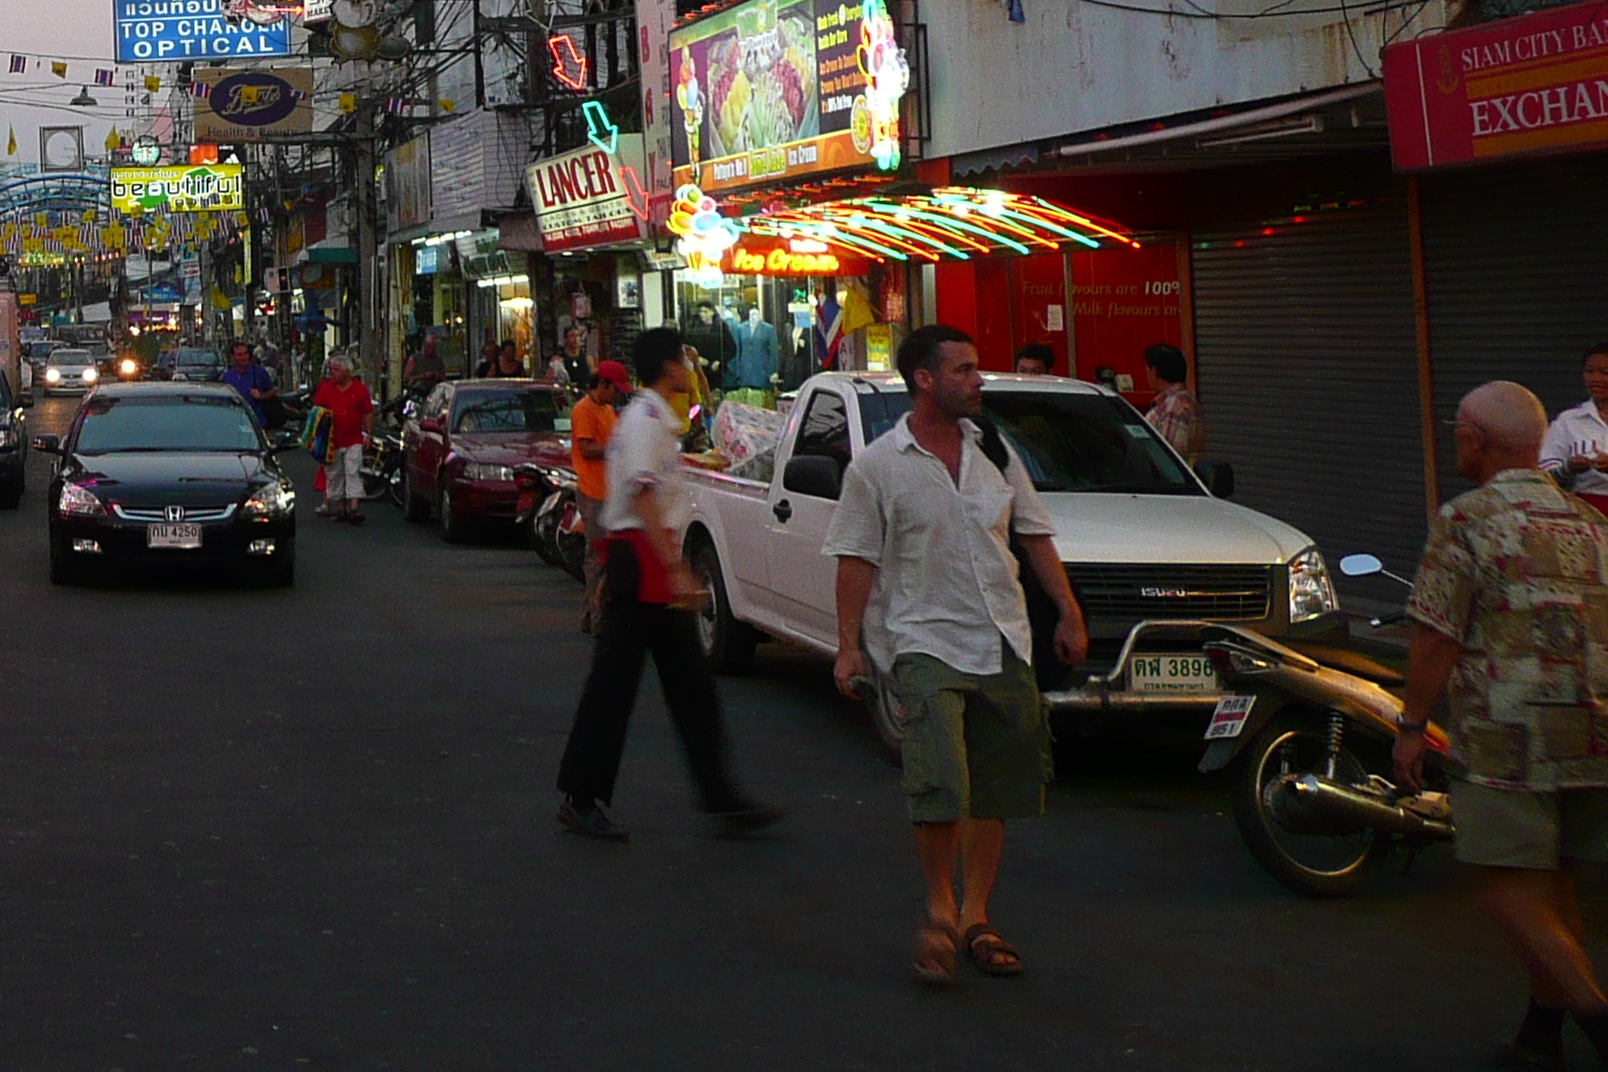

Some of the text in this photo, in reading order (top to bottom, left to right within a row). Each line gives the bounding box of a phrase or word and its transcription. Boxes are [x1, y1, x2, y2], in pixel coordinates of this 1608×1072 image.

[121, 21, 166, 39] TOP
[133, 35, 275, 58] OPTICAL
[1461, 40, 1512, 72] SIAM
[1515, 28, 1566, 60] CITY
[113, 175, 242, 197] beautiful
[535, 150, 617, 208] LANCER
[734, 248, 840, 271] Ice Cream
[1116, 283, 1138, 296] are
[1073, 302, 1104, 316] Milk
[1107, 301, 1160, 319] flavours
[171, 526, 198, 538] 4250
[1141, 587, 1187, 597] ISUZU
[1168, 659, 1214, 677] 3896
